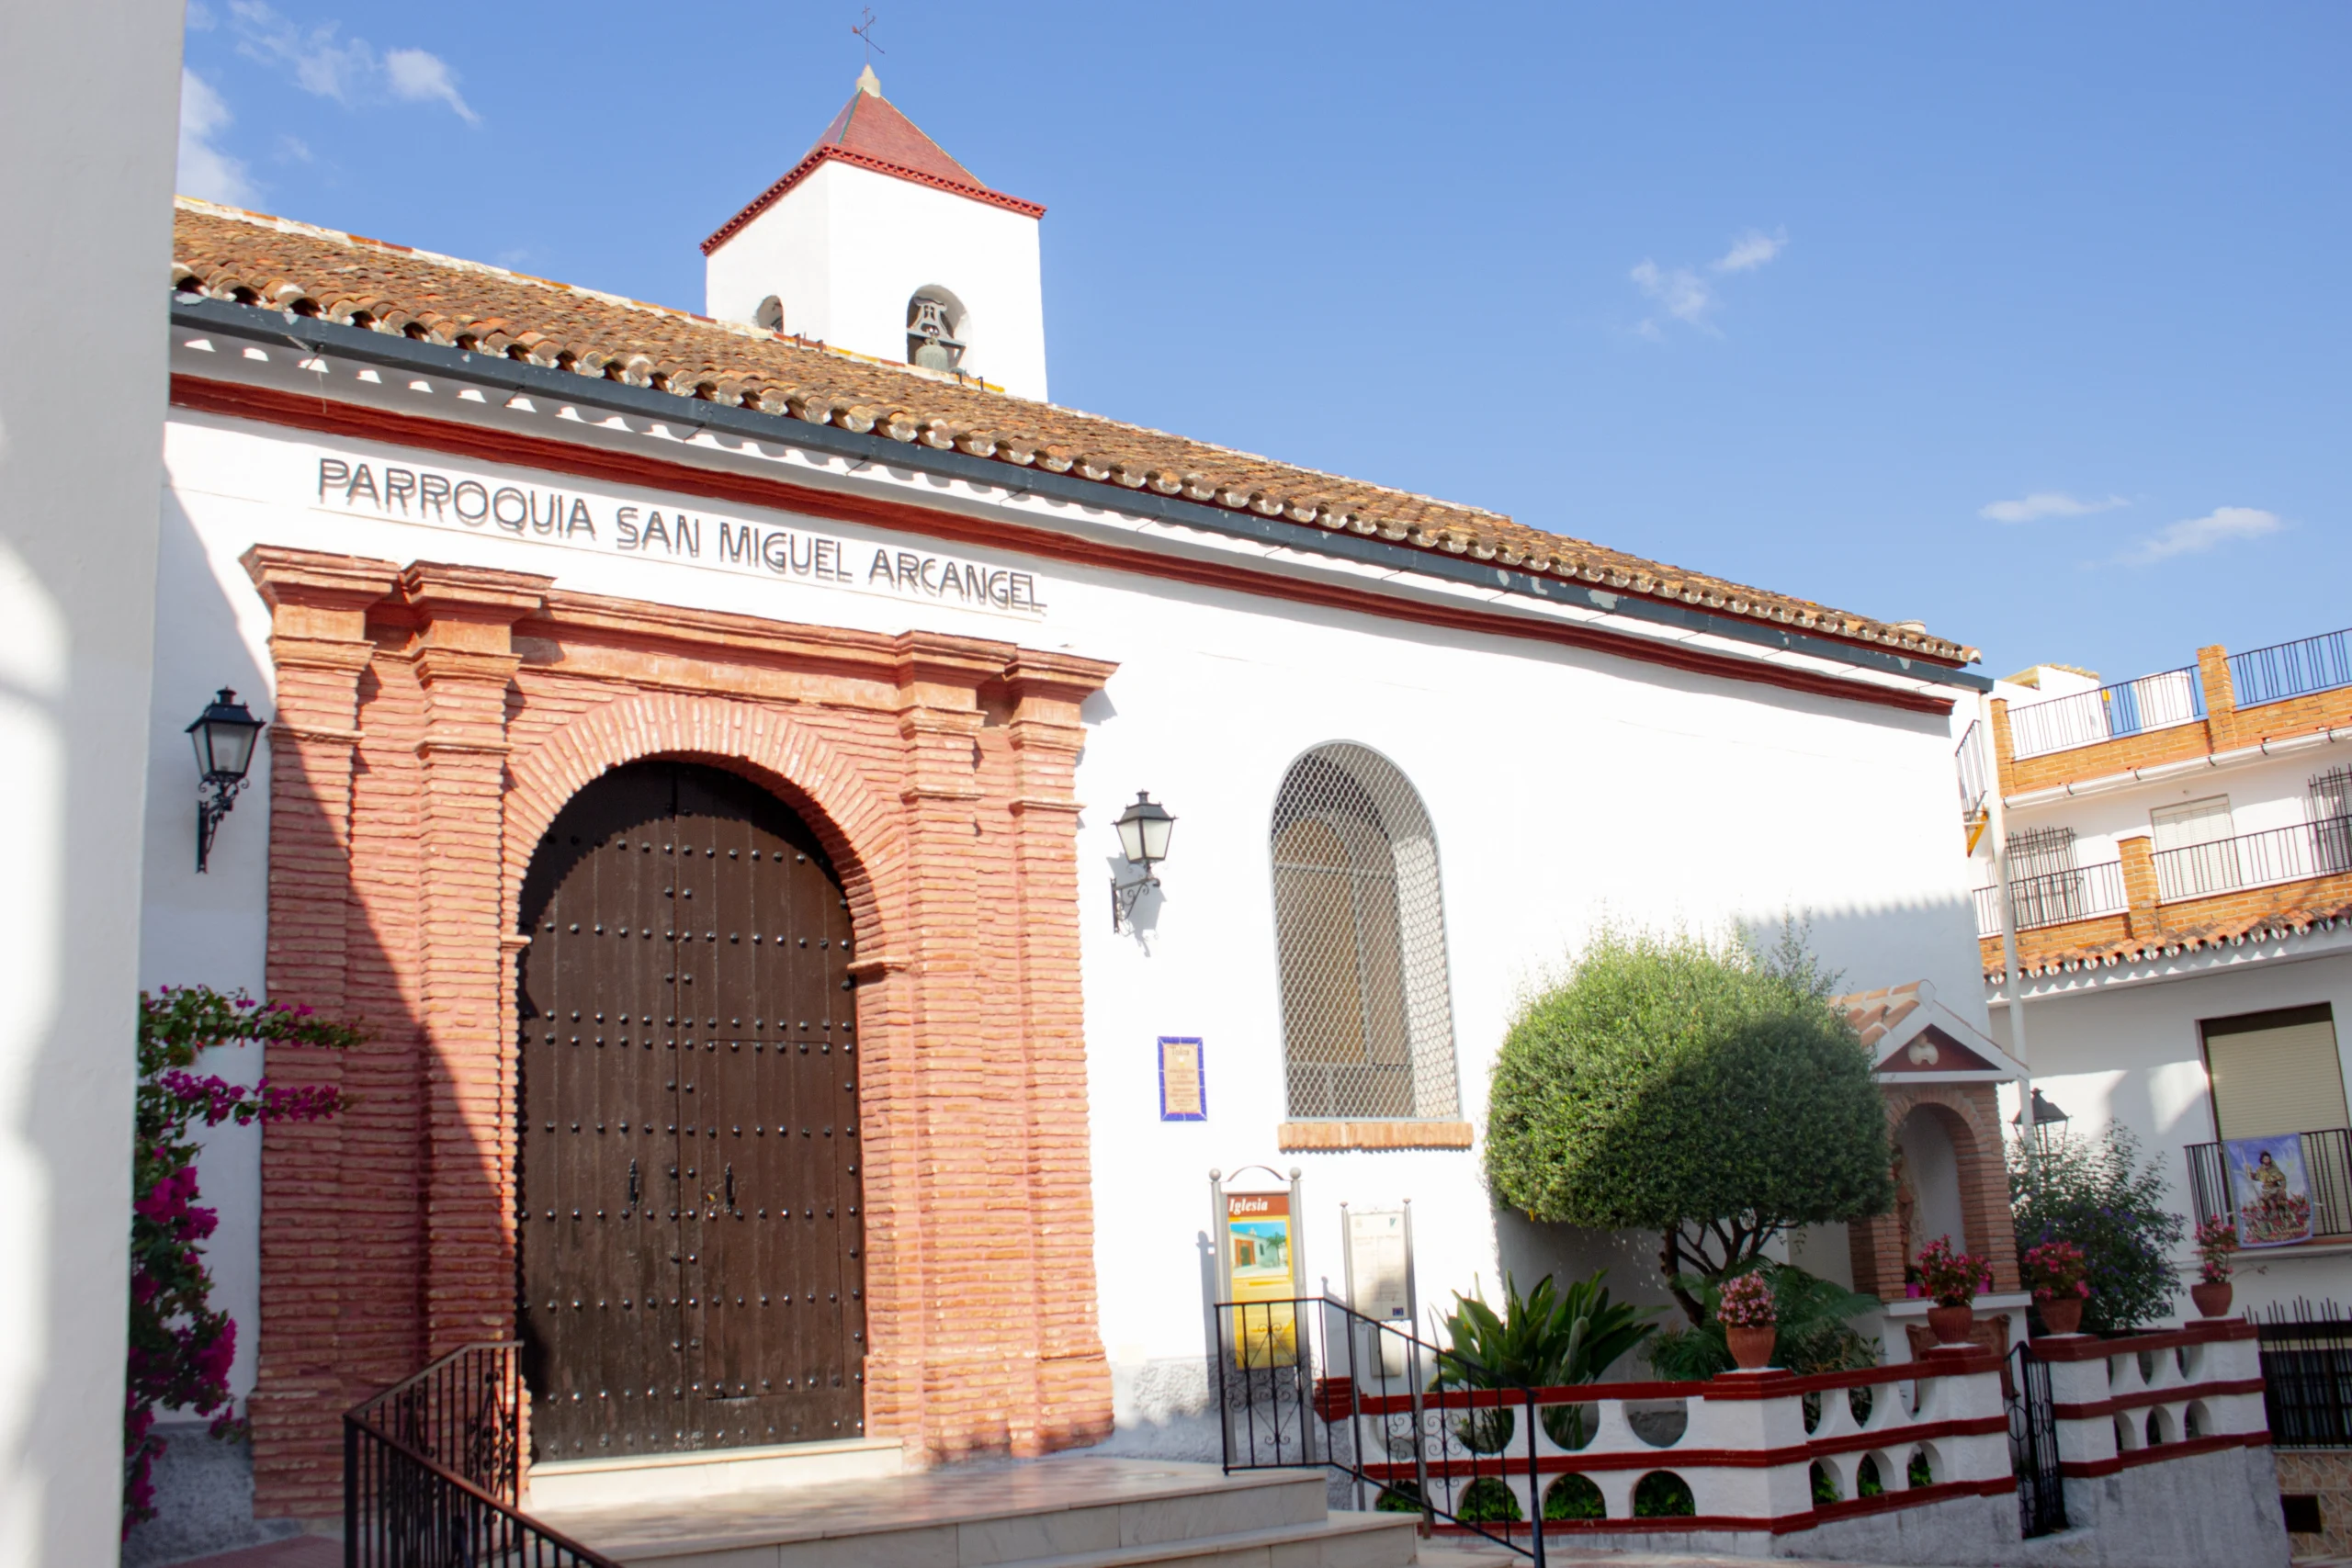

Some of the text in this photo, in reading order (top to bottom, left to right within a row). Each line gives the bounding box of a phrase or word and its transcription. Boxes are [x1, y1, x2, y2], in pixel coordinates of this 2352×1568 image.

[318, 457, 1047, 609] PARROQUIA SAN MIGUEL ARCANGEL
[1228, 1197, 1269, 1215] Iglesia
